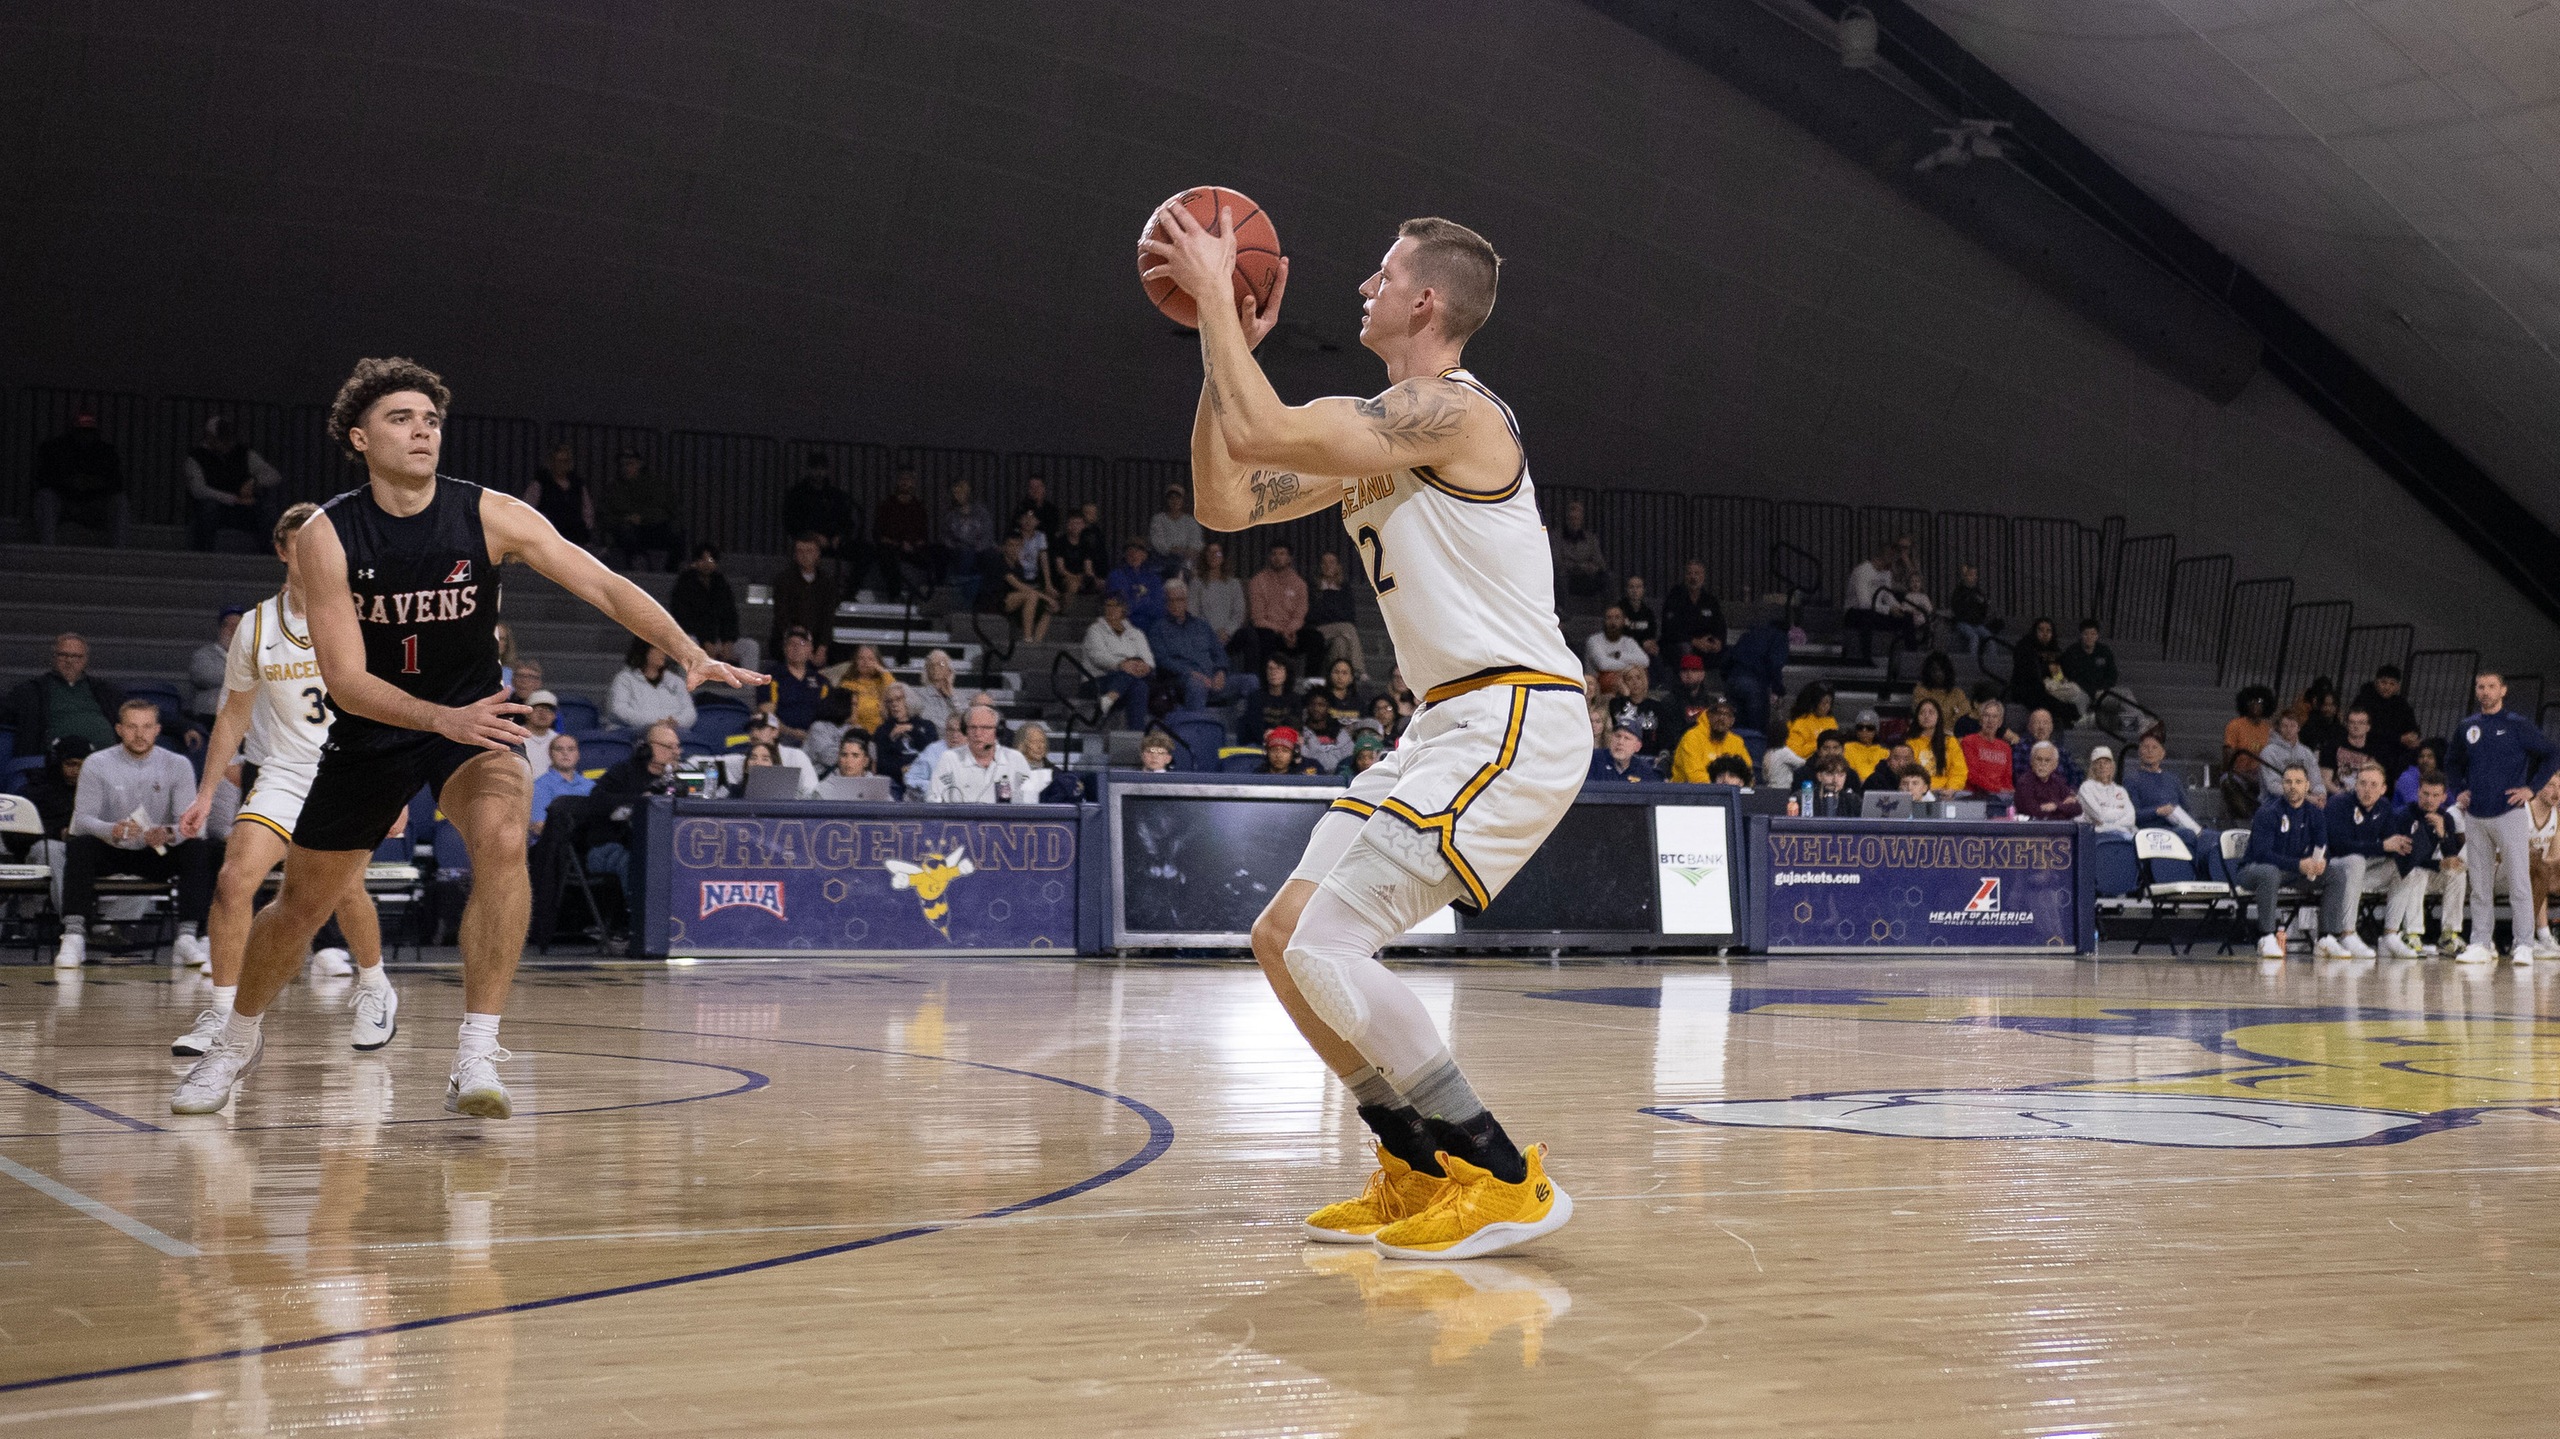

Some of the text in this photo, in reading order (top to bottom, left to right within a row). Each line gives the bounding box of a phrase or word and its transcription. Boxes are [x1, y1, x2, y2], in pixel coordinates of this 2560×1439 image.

[1251, 473, 1299, 506] 719
[1358, 522, 1399, 600] 2
[351, 585, 478, 624] RAVENS
[401, 634, 421, 674] 1
[302, 686, 326, 724] 3
[675, 818, 1076, 870] GRACELAND
[1660, 853, 1724, 865] BTC BANK
[1769, 834, 2072, 870] YELLOWJACKETS
[1774, 871, 1860, 886] gujackets.com
[701, 881, 785, 913] NAIA
[1929, 911, 1968, 921] HEART
[1982, 911, 2034, 921] AMERICA
